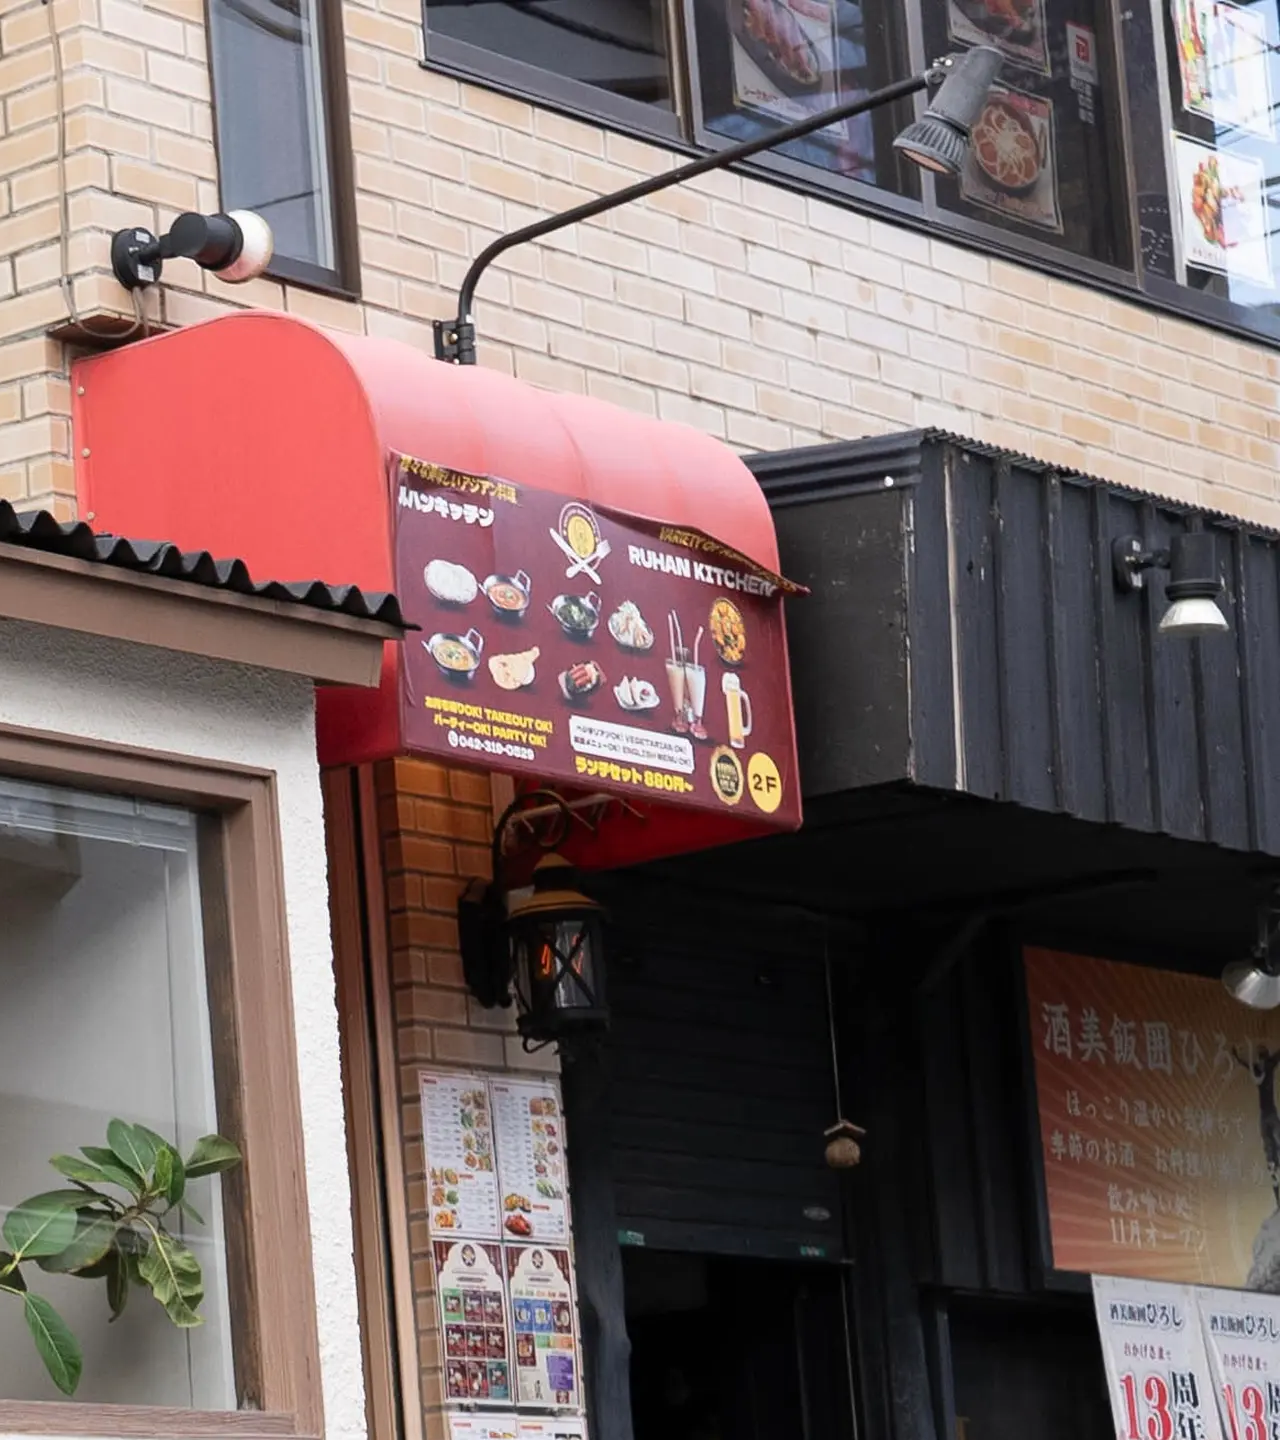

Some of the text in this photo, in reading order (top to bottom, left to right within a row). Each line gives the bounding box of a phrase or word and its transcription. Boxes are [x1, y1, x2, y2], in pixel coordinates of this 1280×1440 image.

[398, 485, 495, 527] ルハンキッチン
[627, 545, 691, 578] RUHAN
[693, 561, 778, 597] KITCHEN
[484, 707, 535, 730] TAKEOUT
[492, 725, 529, 743] PARTY
[575, 755, 643, 786] ランチセット
[752, 773, 777, 793] 2F
[1040, 1001, 1266, 1086] 酒美飯囲ひろし
[1110, 1217, 1208, 1253] 11月オープン
